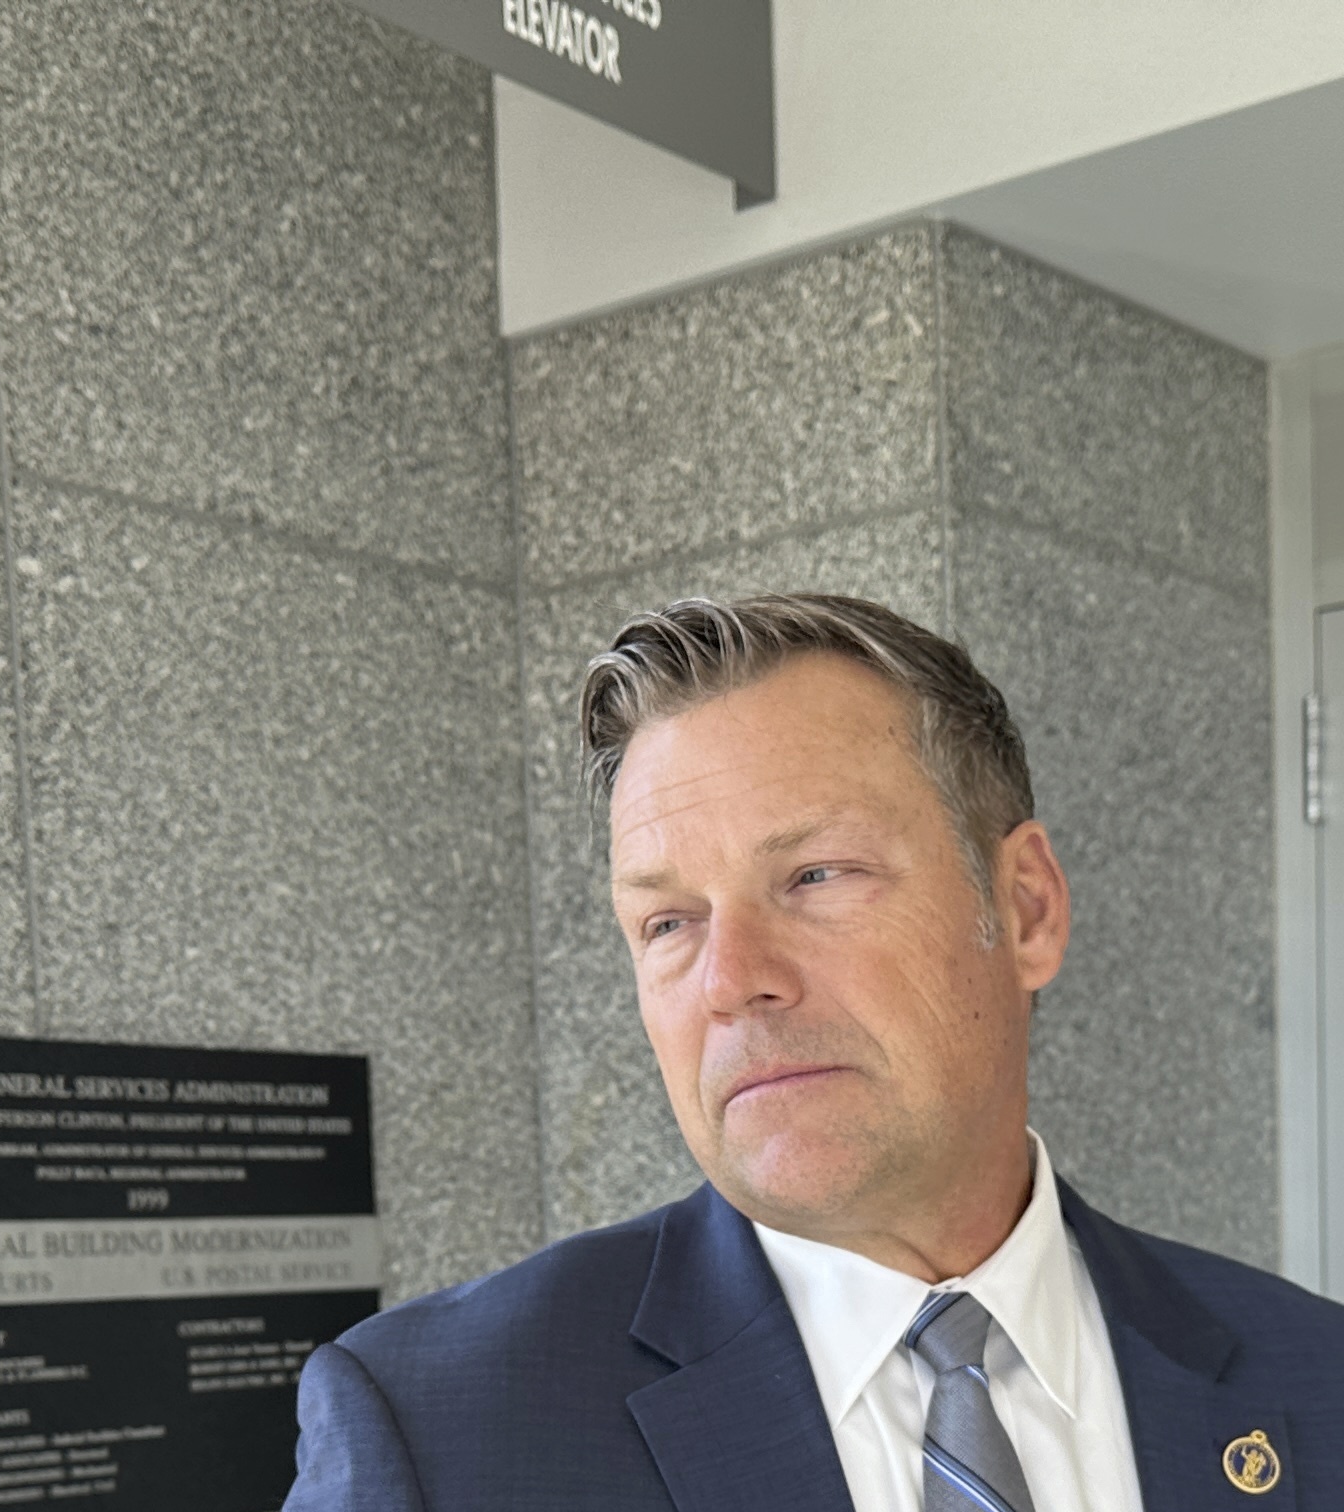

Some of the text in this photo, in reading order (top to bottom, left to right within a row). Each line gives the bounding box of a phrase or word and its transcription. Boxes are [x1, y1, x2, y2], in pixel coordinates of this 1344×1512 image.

[502, 0, 622, 86] ELEVATOR
[73, 1075, 170, 1103] SERVICES
[172, 1079, 330, 1106] ADMINISTRATION
[128, 1112, 204, 1132] PRESIDENT
[205, 1114, 224, 1132] OF
[227, 1114, 254, 1133] THE
[256, 1115, 305, 1135] UNITED
[307, 1116, 352, 1136] STATES
[126, 1187, 170, 1212] 1999
[43, 1229, 163, 1257] BUILDING
[170, 1226, 351, 1253] MODERNIZATION
[205, 1263, 272, 1287] POSTAL
[279, 1260, 351, 1282] SERVICE
